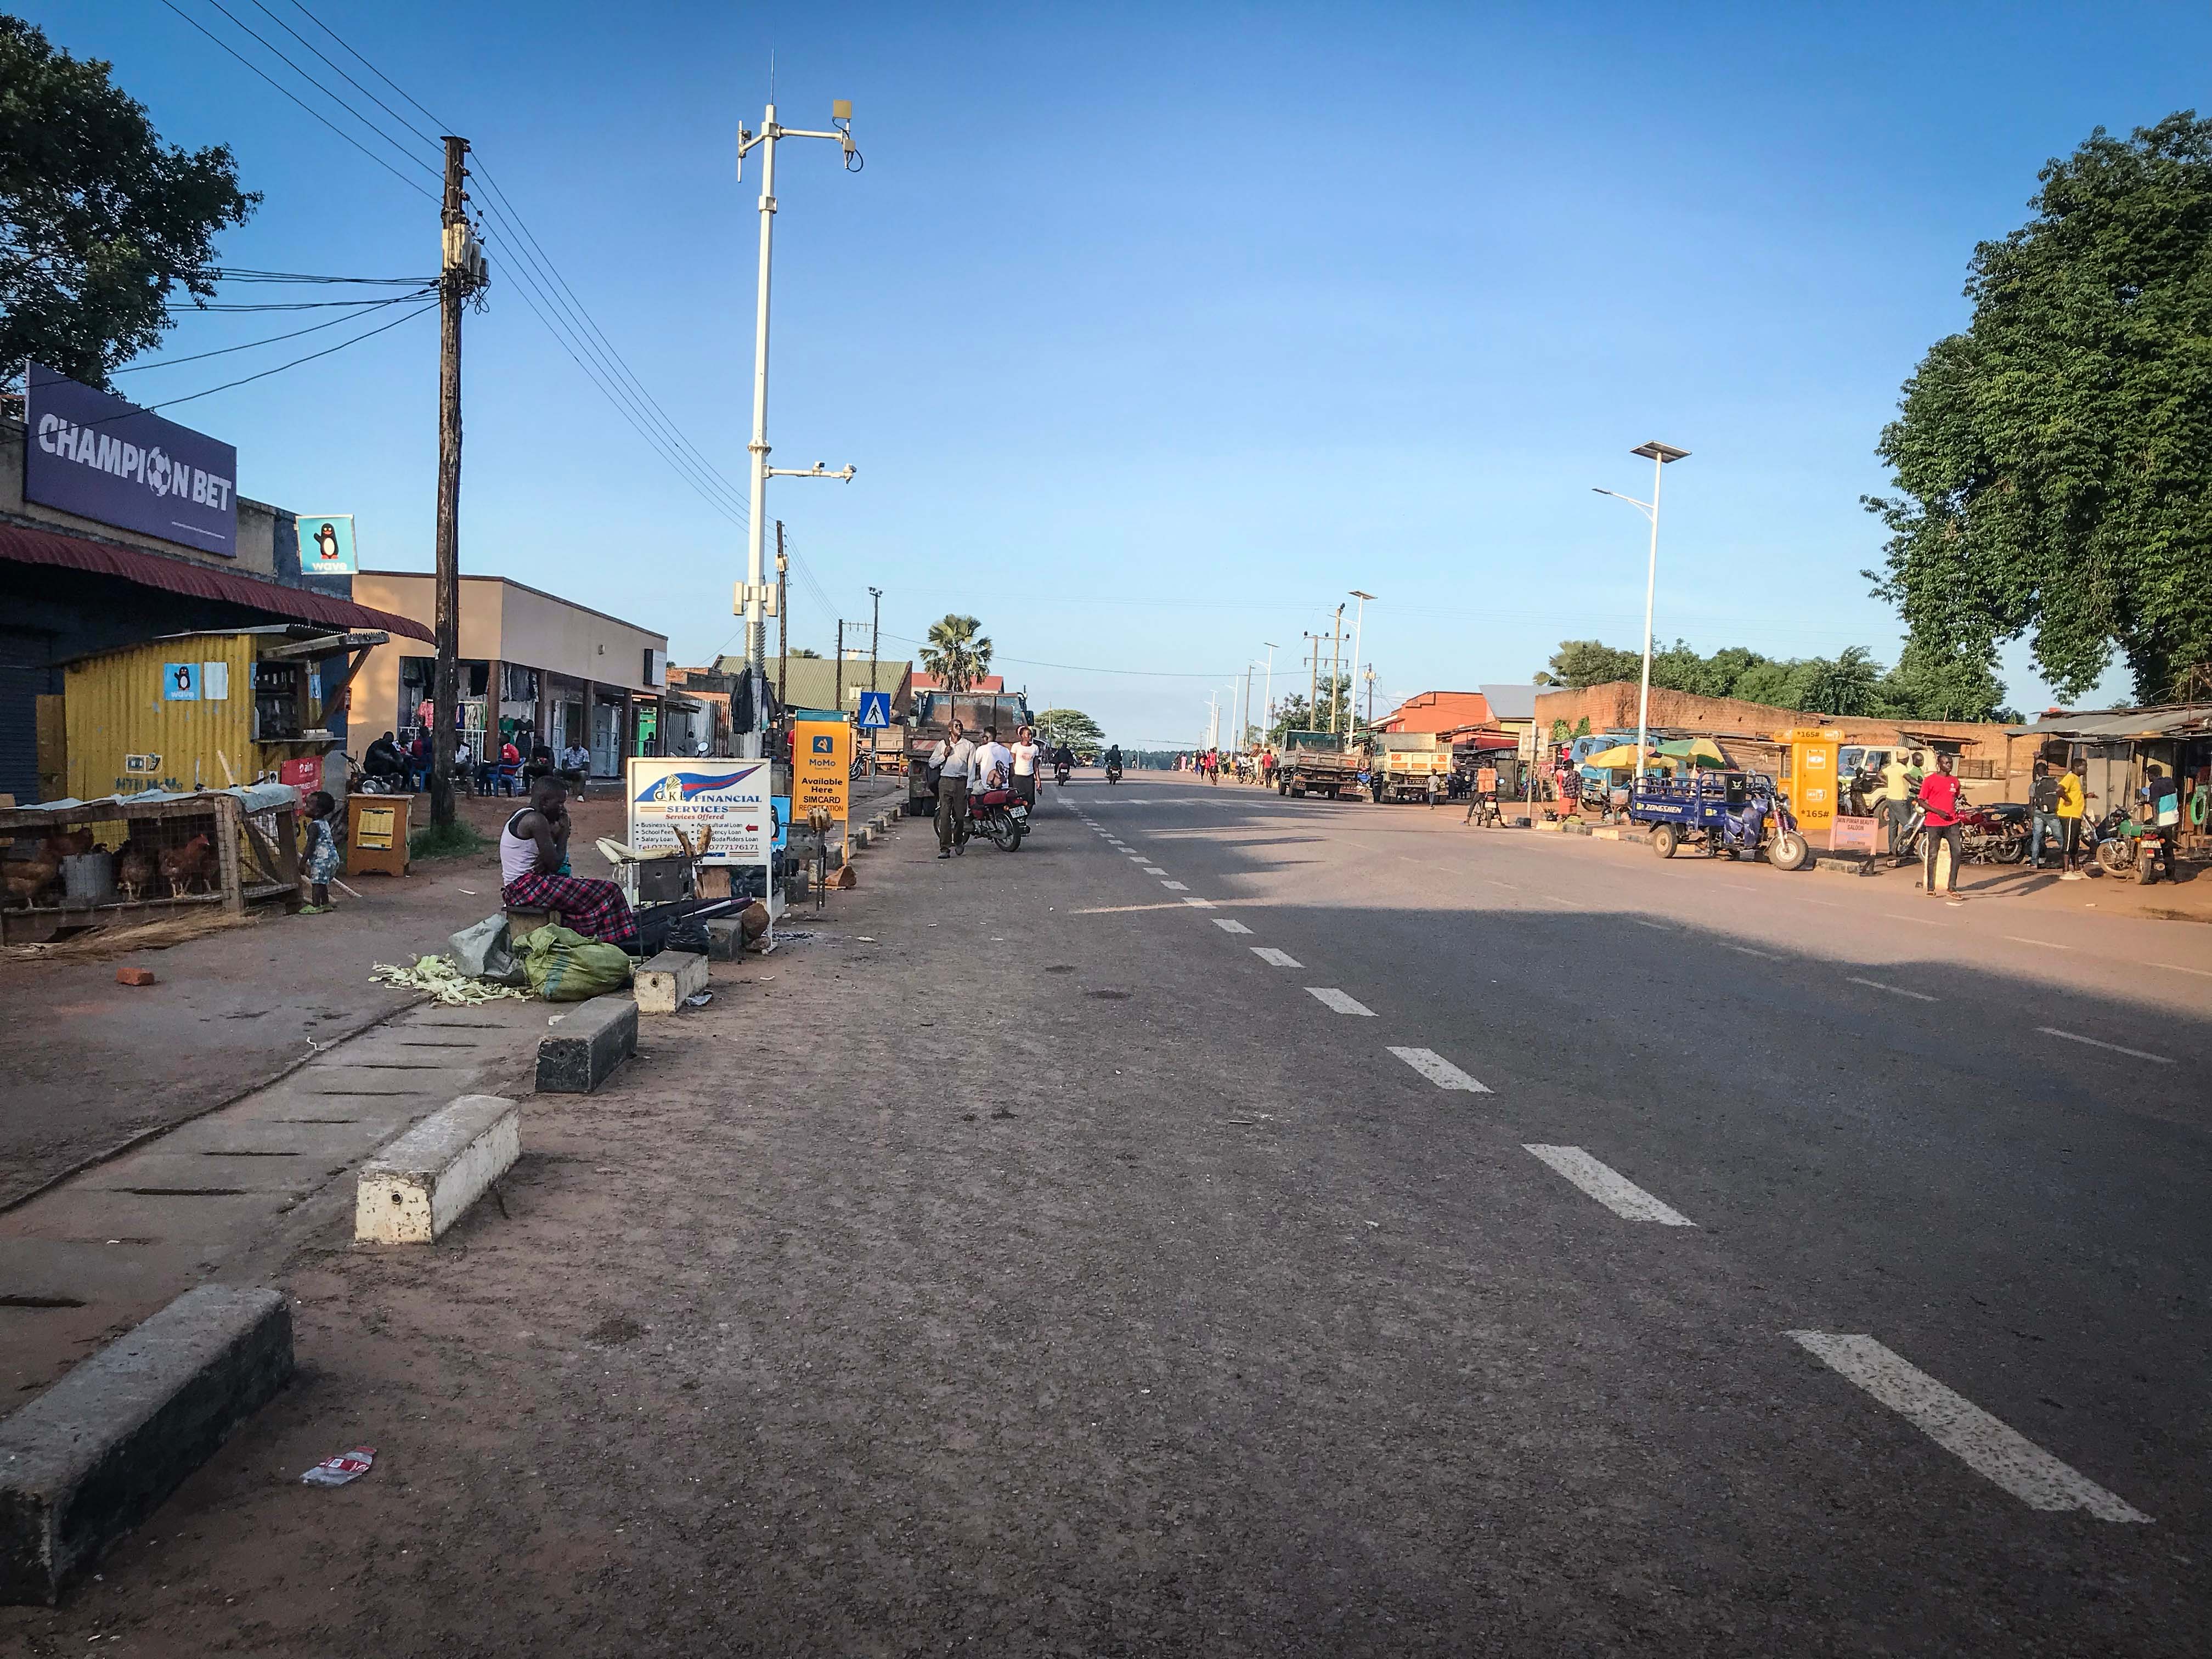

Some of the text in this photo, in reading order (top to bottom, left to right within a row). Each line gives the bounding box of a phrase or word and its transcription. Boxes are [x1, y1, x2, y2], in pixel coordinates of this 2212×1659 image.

[38, 413, 232, 511] CHAMPION BET
[312, 562, 347, 571] wave
[146, 777, 183, 791] MMo
[802, 777, 843, 786] Available
[1645, 804, 1683, 814] ZONGSHEN
